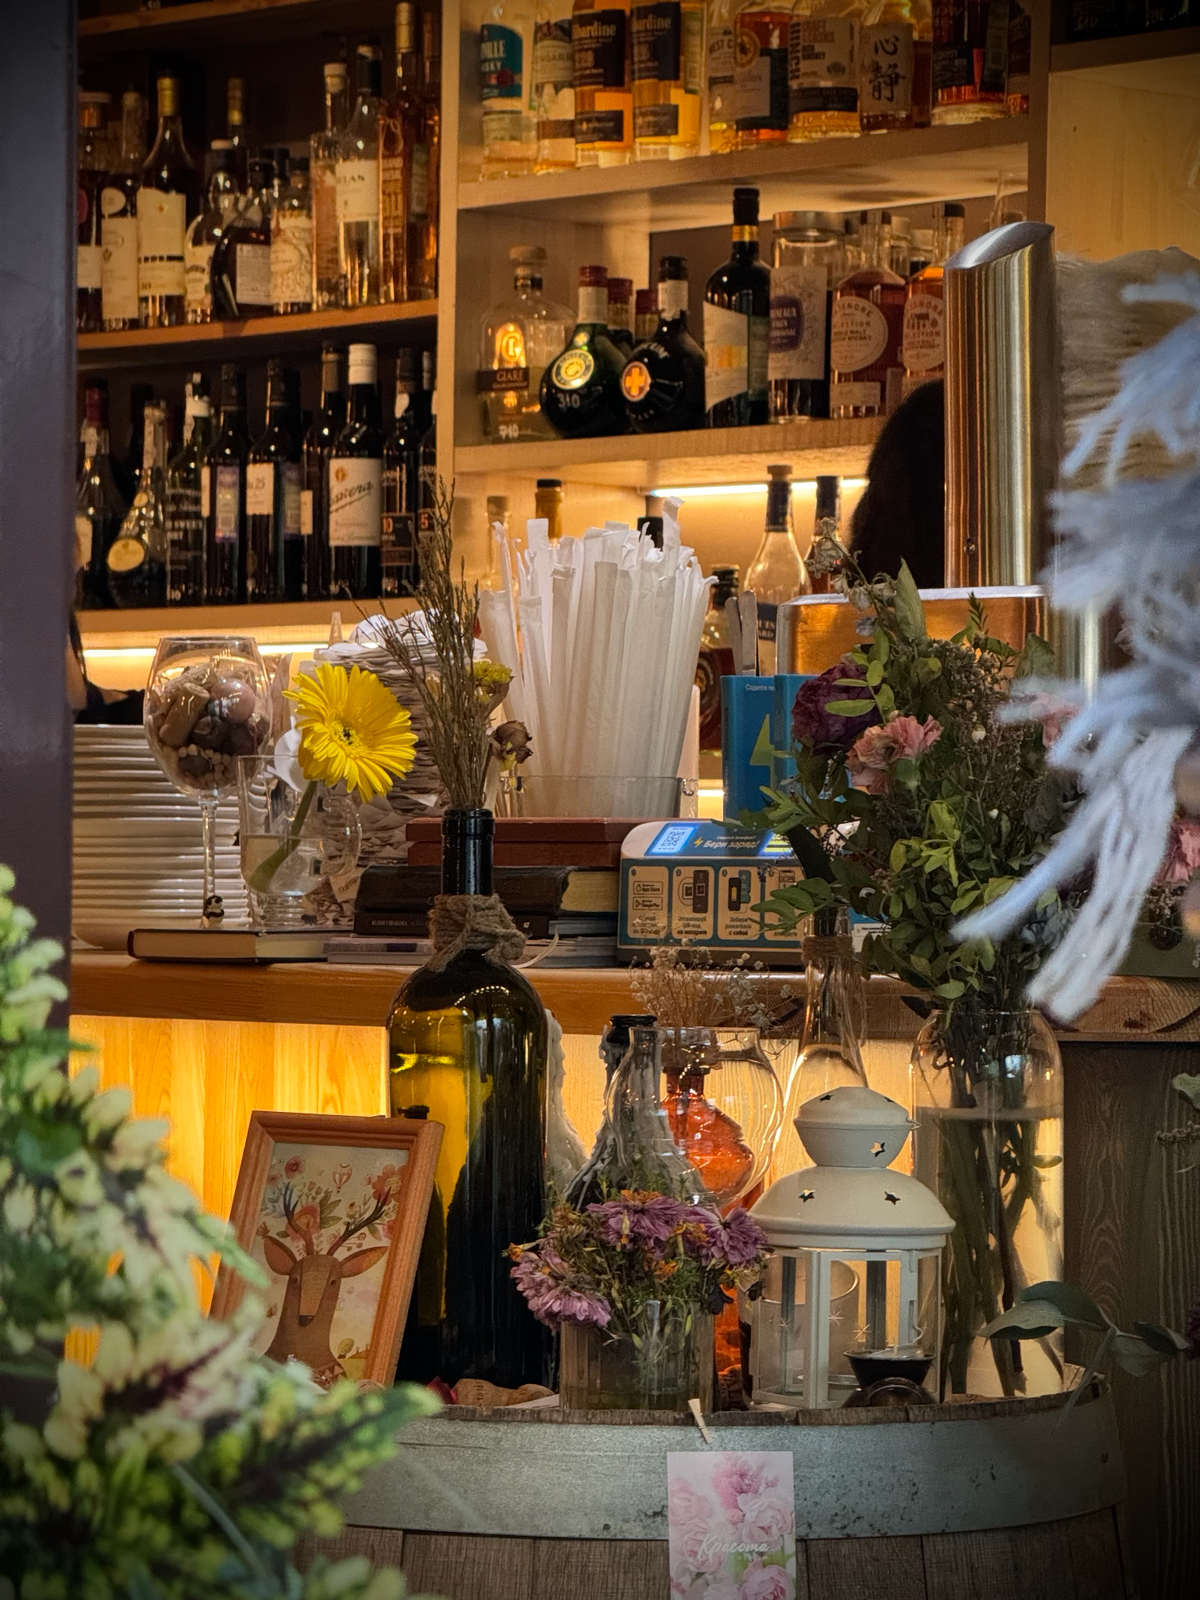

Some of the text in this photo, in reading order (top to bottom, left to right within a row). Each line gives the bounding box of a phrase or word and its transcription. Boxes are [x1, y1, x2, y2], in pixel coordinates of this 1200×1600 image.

[703, 840, 760, 850] Бери заряд!
[699, 1533, 770, 1562] Красота
